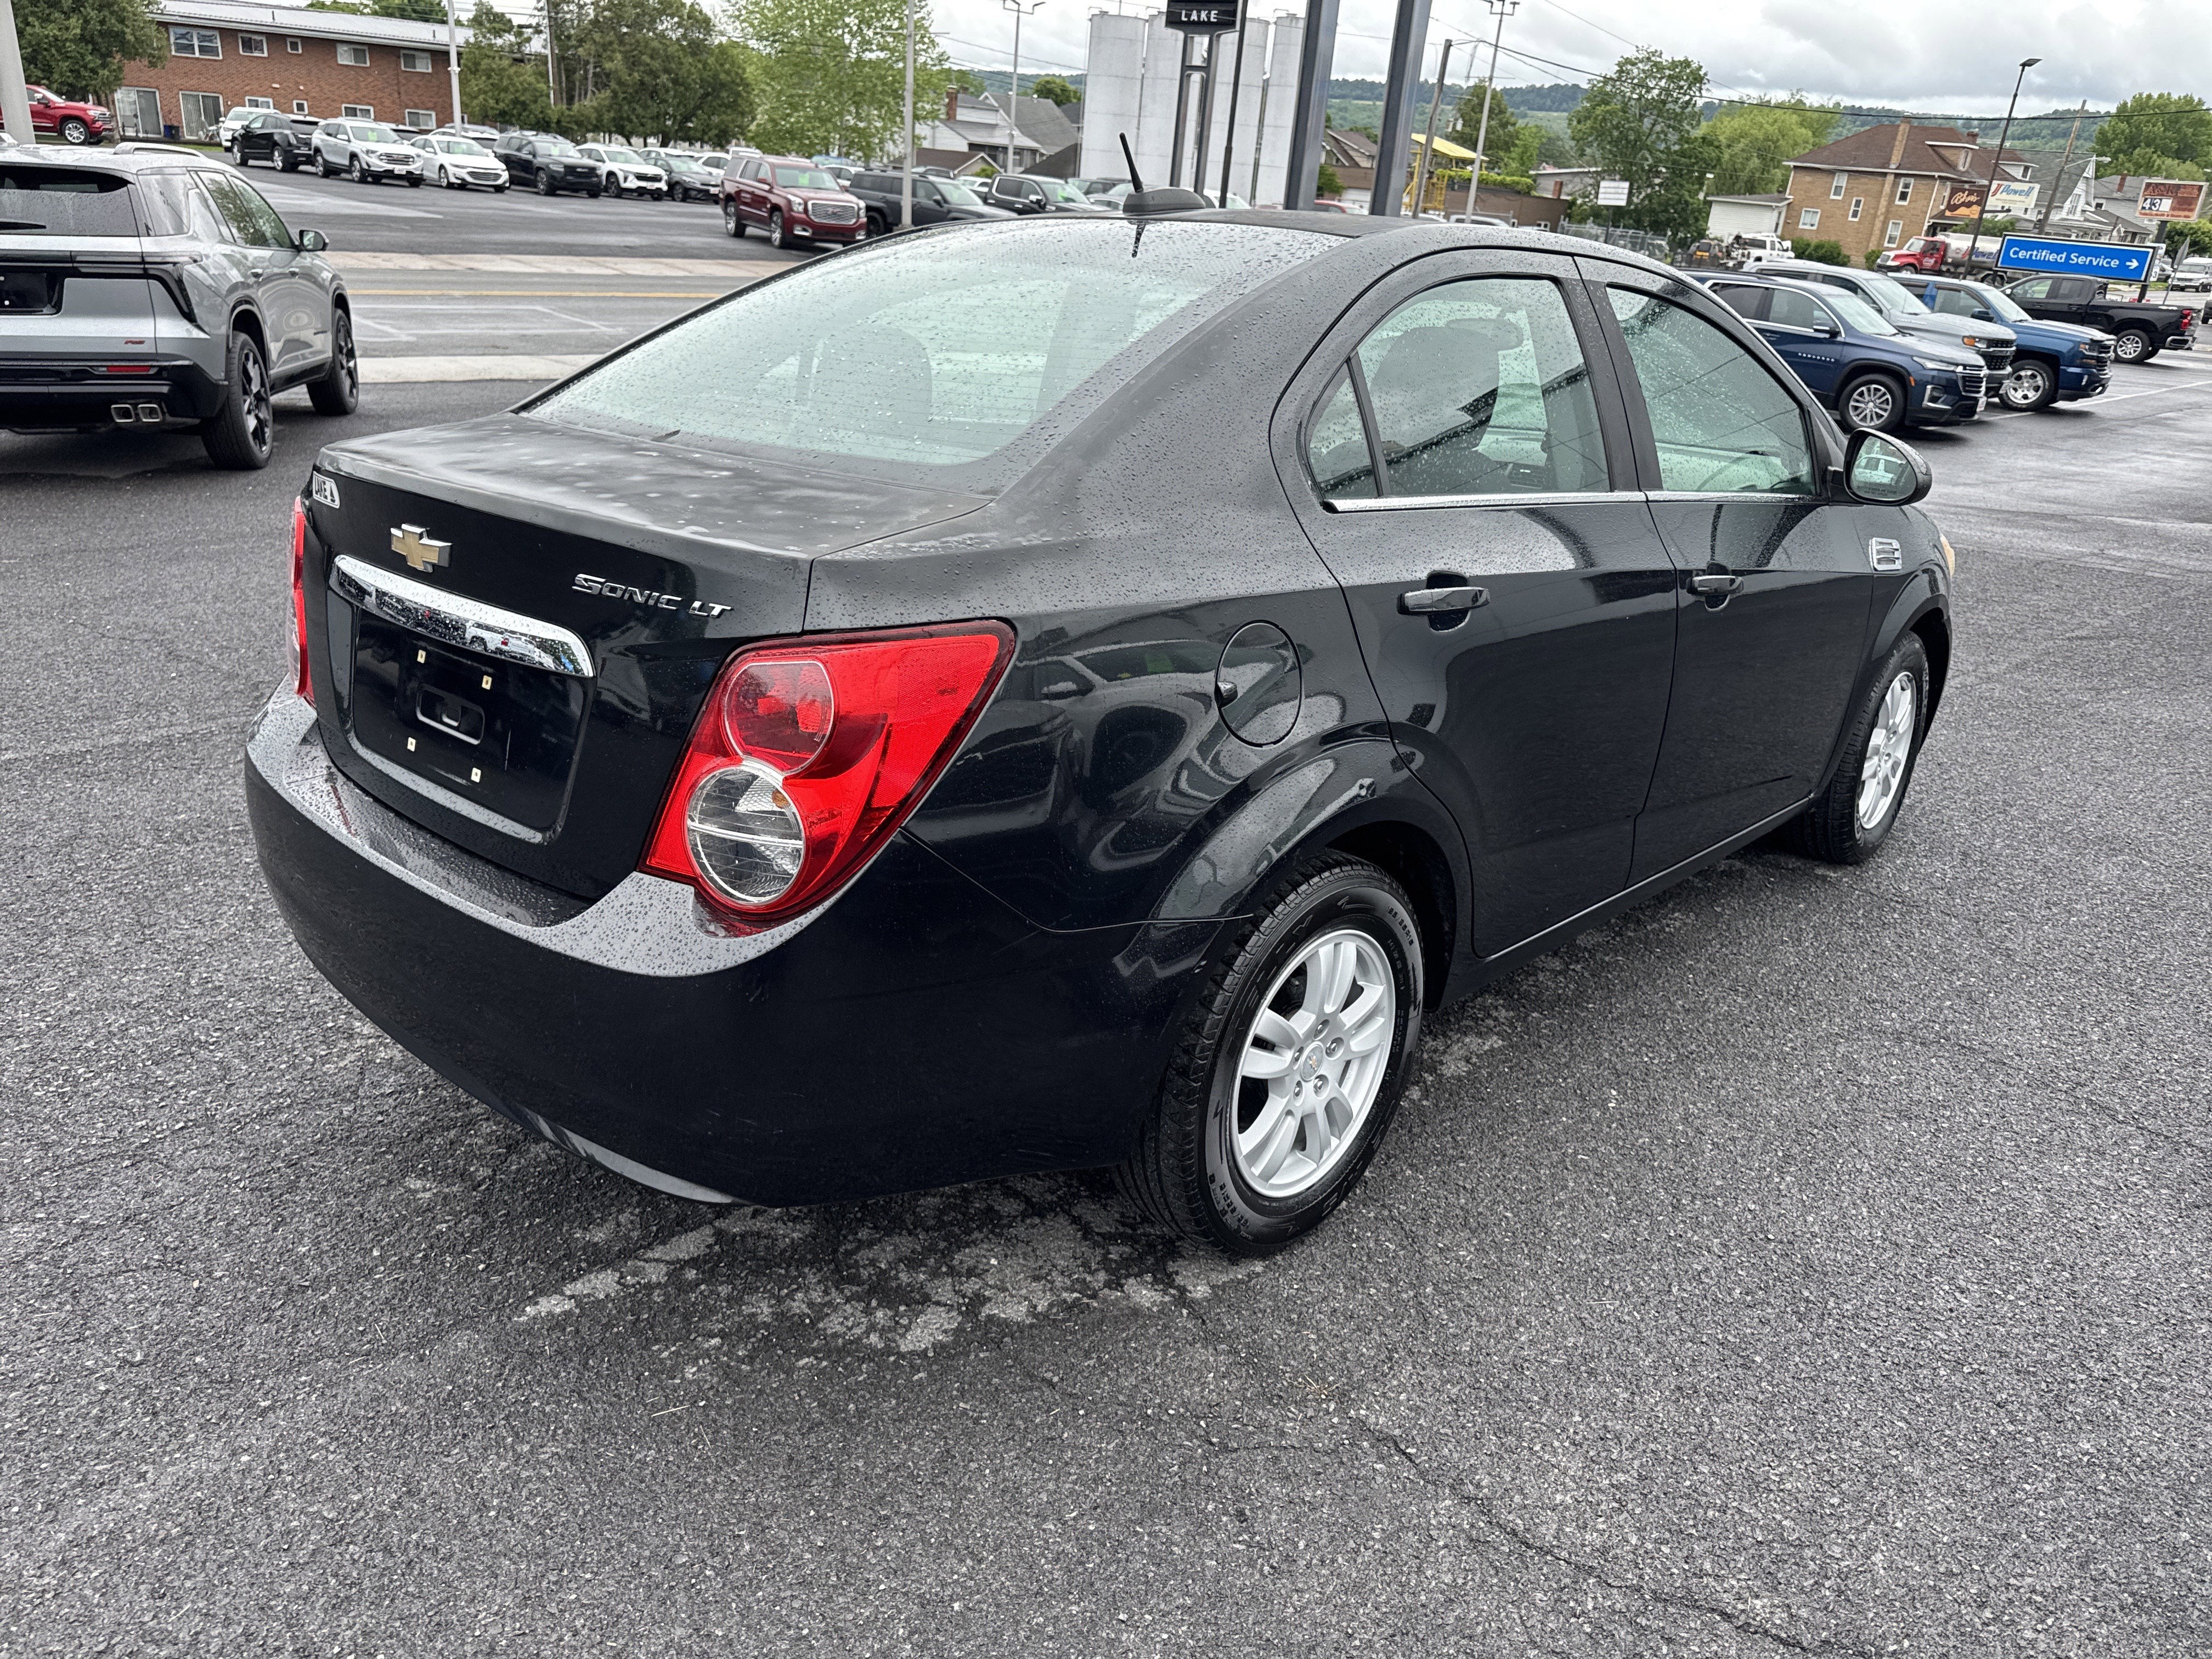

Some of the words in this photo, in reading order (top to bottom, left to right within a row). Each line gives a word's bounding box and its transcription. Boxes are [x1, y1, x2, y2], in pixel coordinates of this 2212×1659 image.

[1181, 10, 1218, 22] LAKE
[2009, 247, 2067, 263] Certified
[2068, 252, 2120, 268] Service
[314, 476, 328, 500] LAKE
[688, 601, 733, 619] LT
